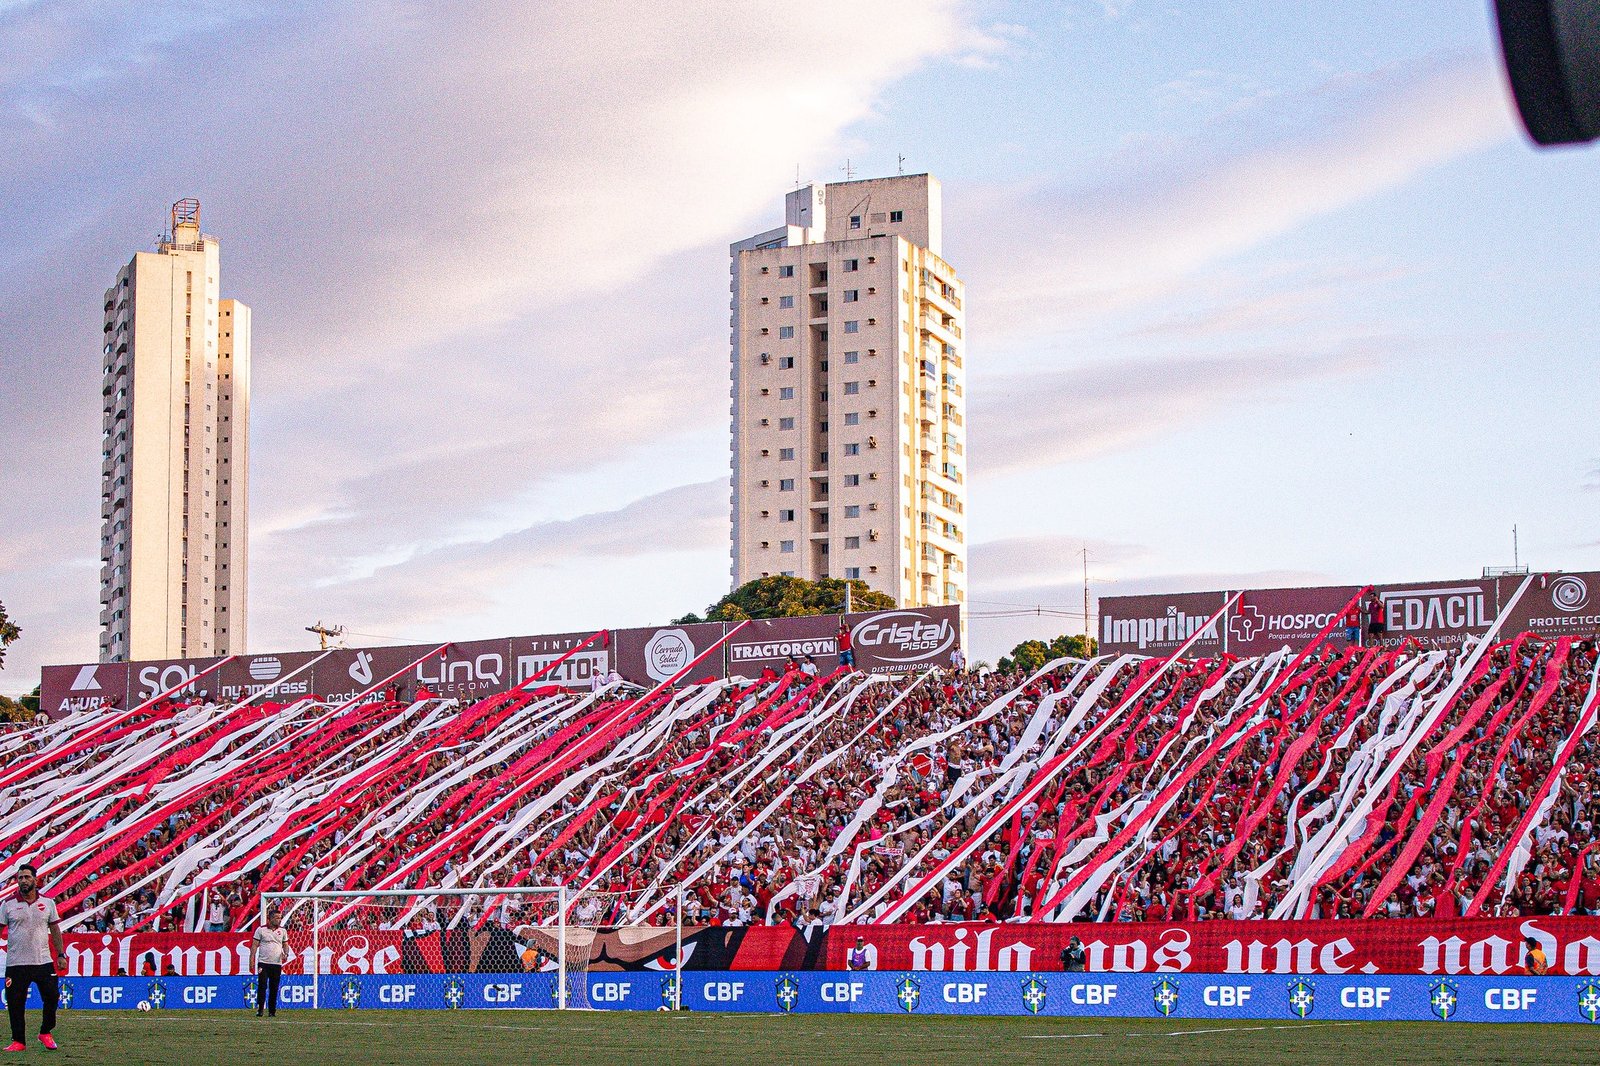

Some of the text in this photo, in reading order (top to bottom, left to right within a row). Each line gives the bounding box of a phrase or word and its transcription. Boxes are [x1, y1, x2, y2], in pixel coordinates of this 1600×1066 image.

[858, 618, 949, 646] Cristal
[1103, 606, 1219, 649] Imprilux
[734, 641, 834, 659] TRACTORGYN
[900, 640, 938, 651] PISOS
[871, 662, 935, 673] DISTRIBUIDORA
[427, 682, 489, 692] ELECOM
[91, 987, 123, 1003] CBF
[183, 987, 217, 1003] CBF
[280, 985, 314, 1003] CBF
[379, 985, 416, 1002] CBF
[484, 984, 522, 1002] CBF
[592, 983, 631, 1001] CBF
[703, 983, 744, 1001] CBF
[820, 983, 864, 1002] CBF
[943, 984, 988, 1003] CBF
[1070, 985, 1118, 1005] CBF
[1203, 986, 1252, 1006] CBF
[1340, 987, 1391, 1008] CBF
[1484, 989, 1537, 1010] CBF
